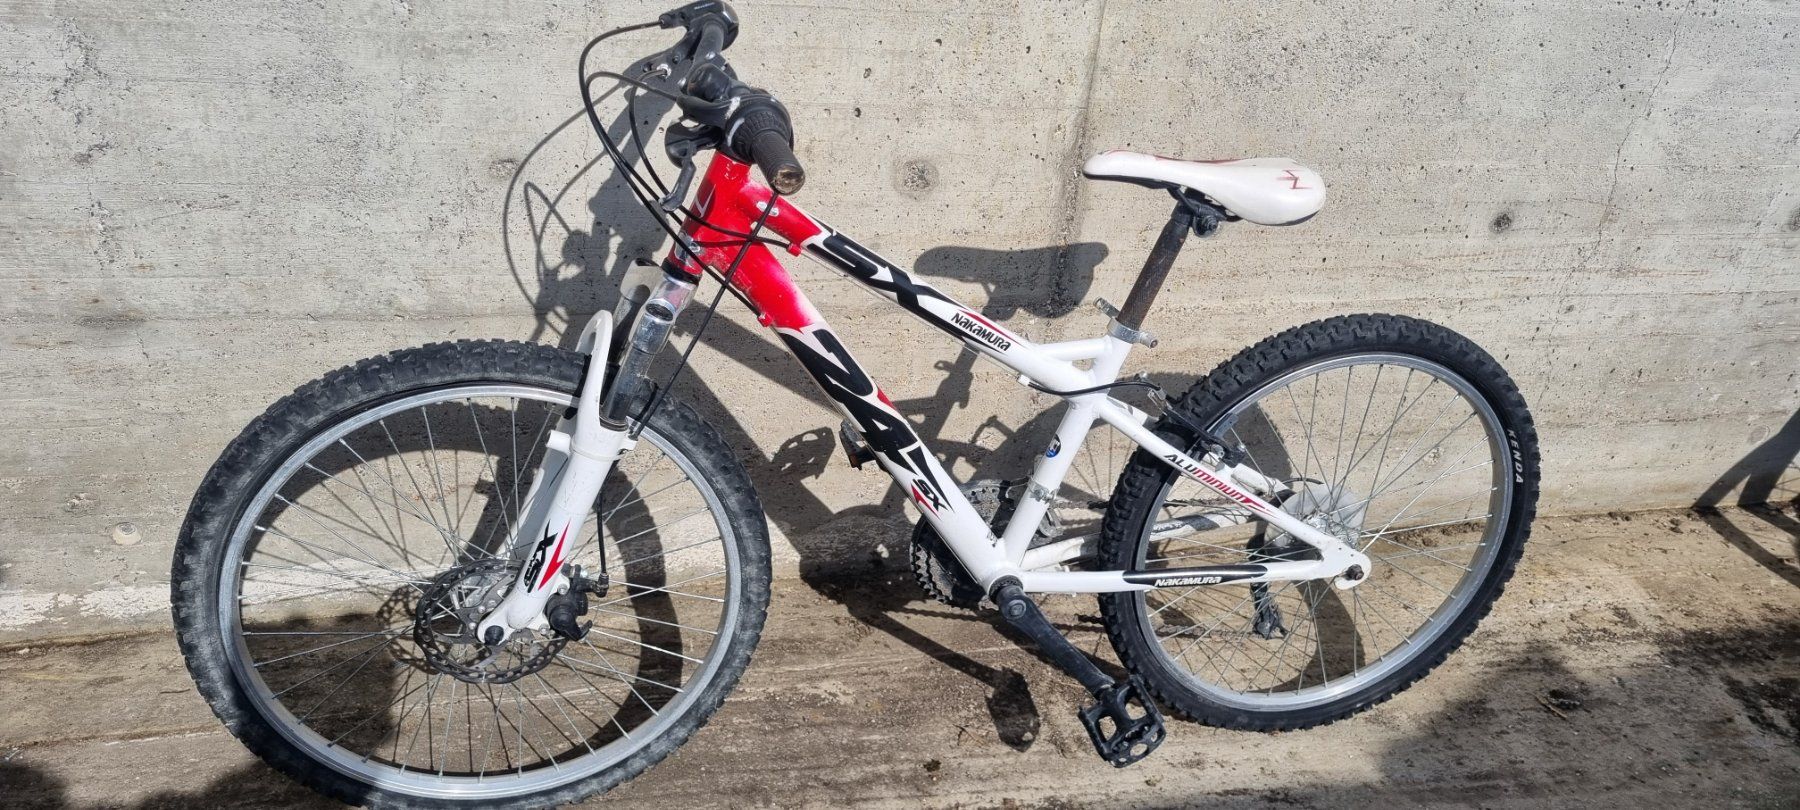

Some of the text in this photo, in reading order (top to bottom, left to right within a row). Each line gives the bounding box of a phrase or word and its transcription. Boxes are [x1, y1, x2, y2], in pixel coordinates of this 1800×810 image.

[1164, 454, 1253, 504] ALUMINIUM
[1508, 429, 1524, 483] KENDA
[1155, 577, 1222, 587] NAKAMURA
